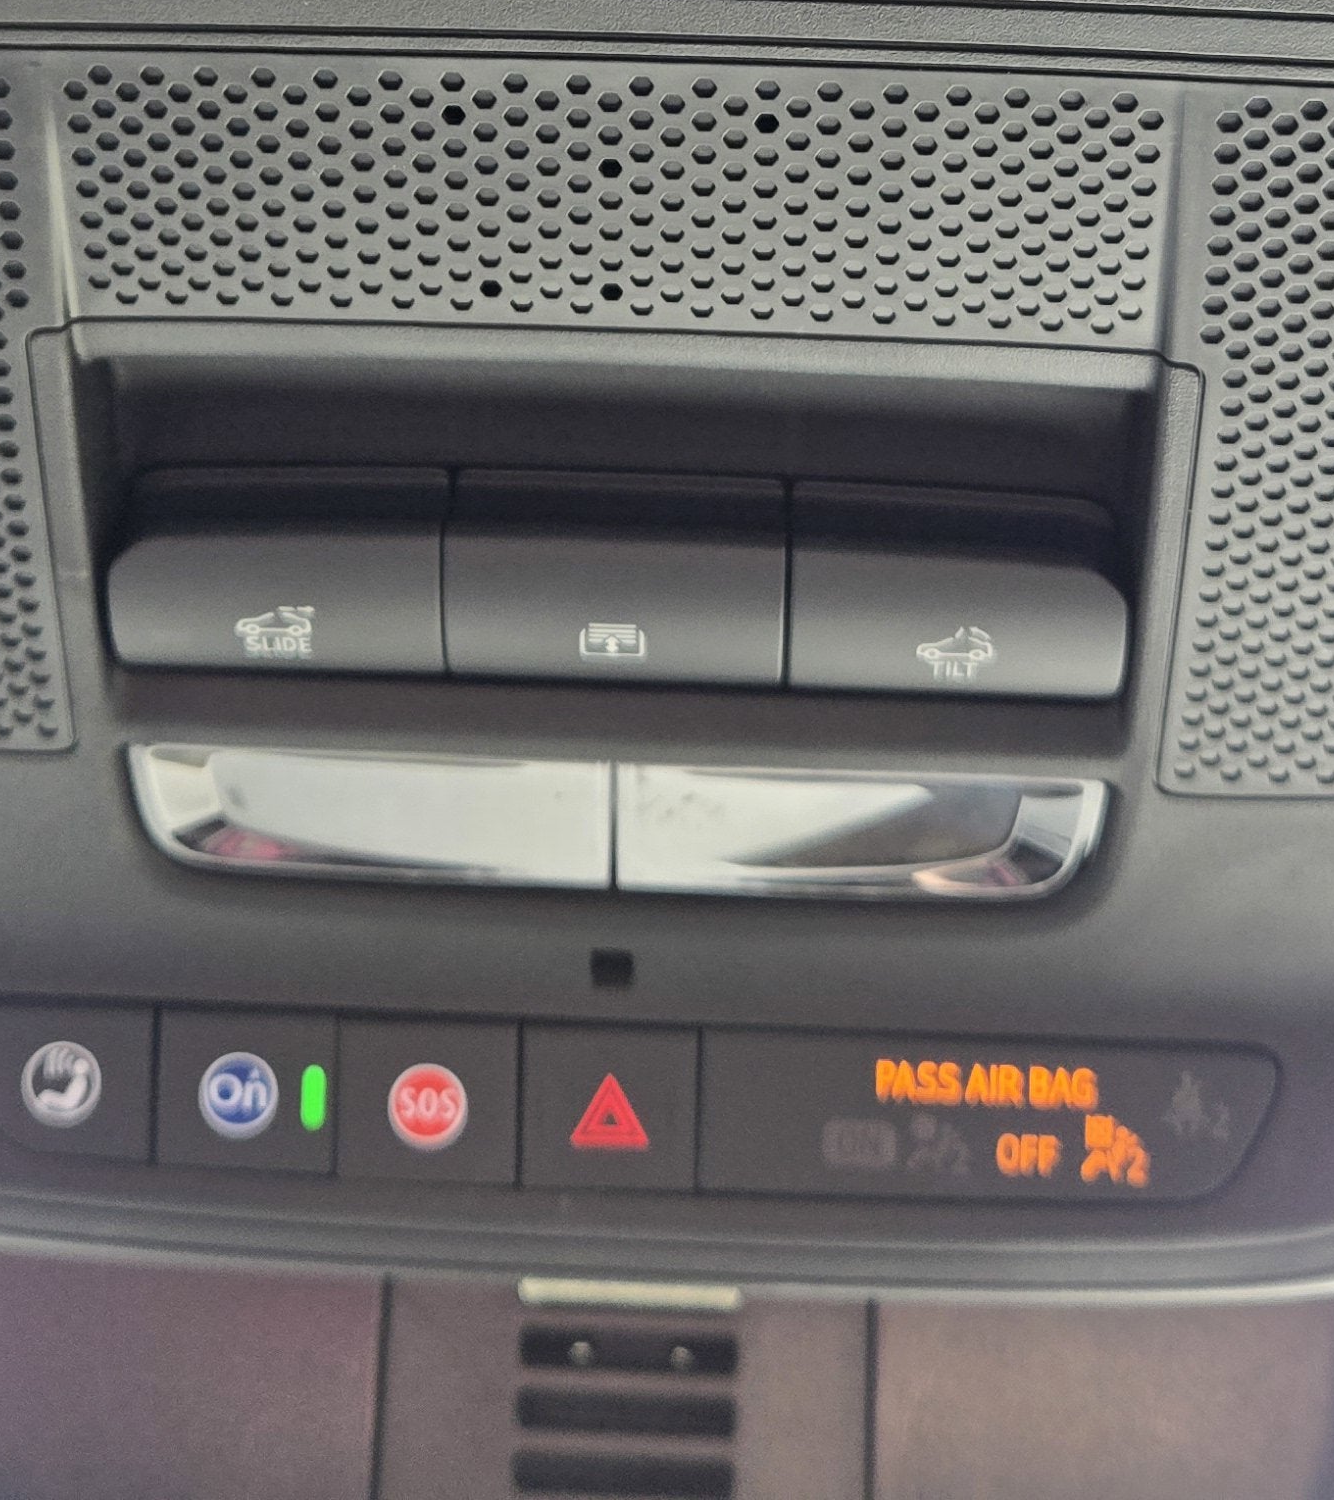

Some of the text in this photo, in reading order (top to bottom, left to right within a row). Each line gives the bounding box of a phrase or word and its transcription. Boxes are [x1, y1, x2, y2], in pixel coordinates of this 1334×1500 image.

[245, 636, 313, 656] SLIDE
[930, 660, 979, 679] TILT
[875, 1059, 1098, 1111] PASS AIR BAG
[400, 1086, 457, 1121] SOS
[996, 1132, 1060, 1178] OFF
